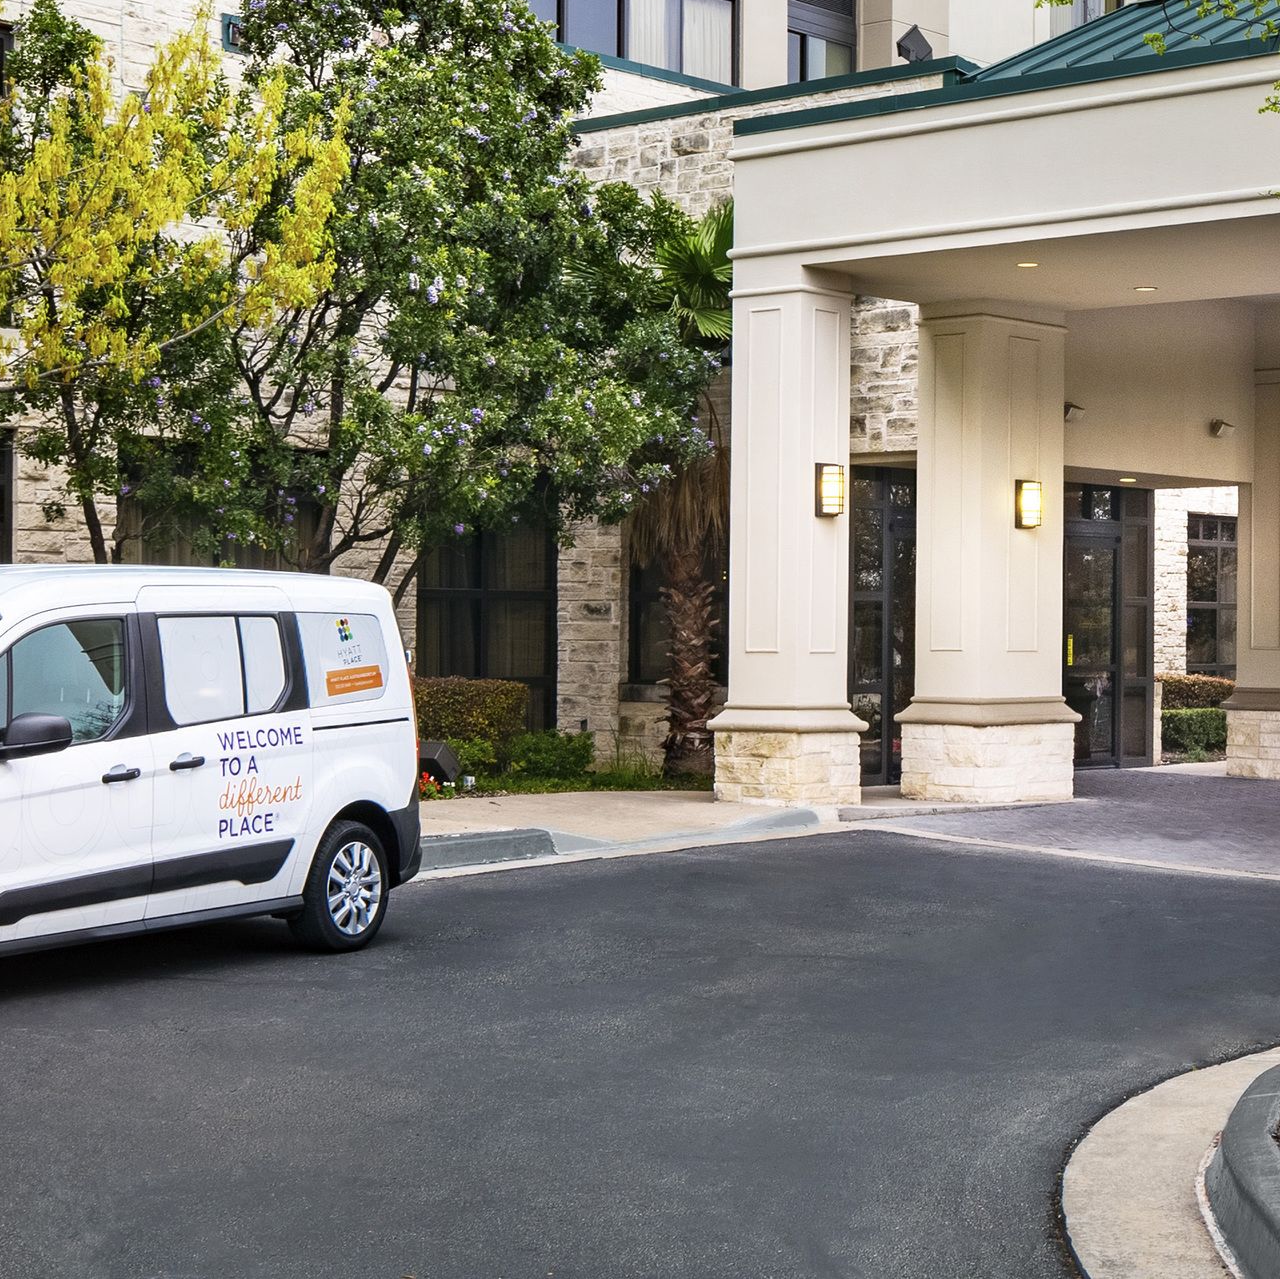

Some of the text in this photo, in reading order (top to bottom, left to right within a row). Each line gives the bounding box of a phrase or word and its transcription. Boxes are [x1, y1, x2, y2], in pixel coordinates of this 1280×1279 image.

[336, 644, 362, 658] HYATT
[217, 726, 303, 751] WELCOME
[220, 755, 258, 776] TO A
[220, 776, 302, 817] different
[219, 813, 274, 839] PLACE
